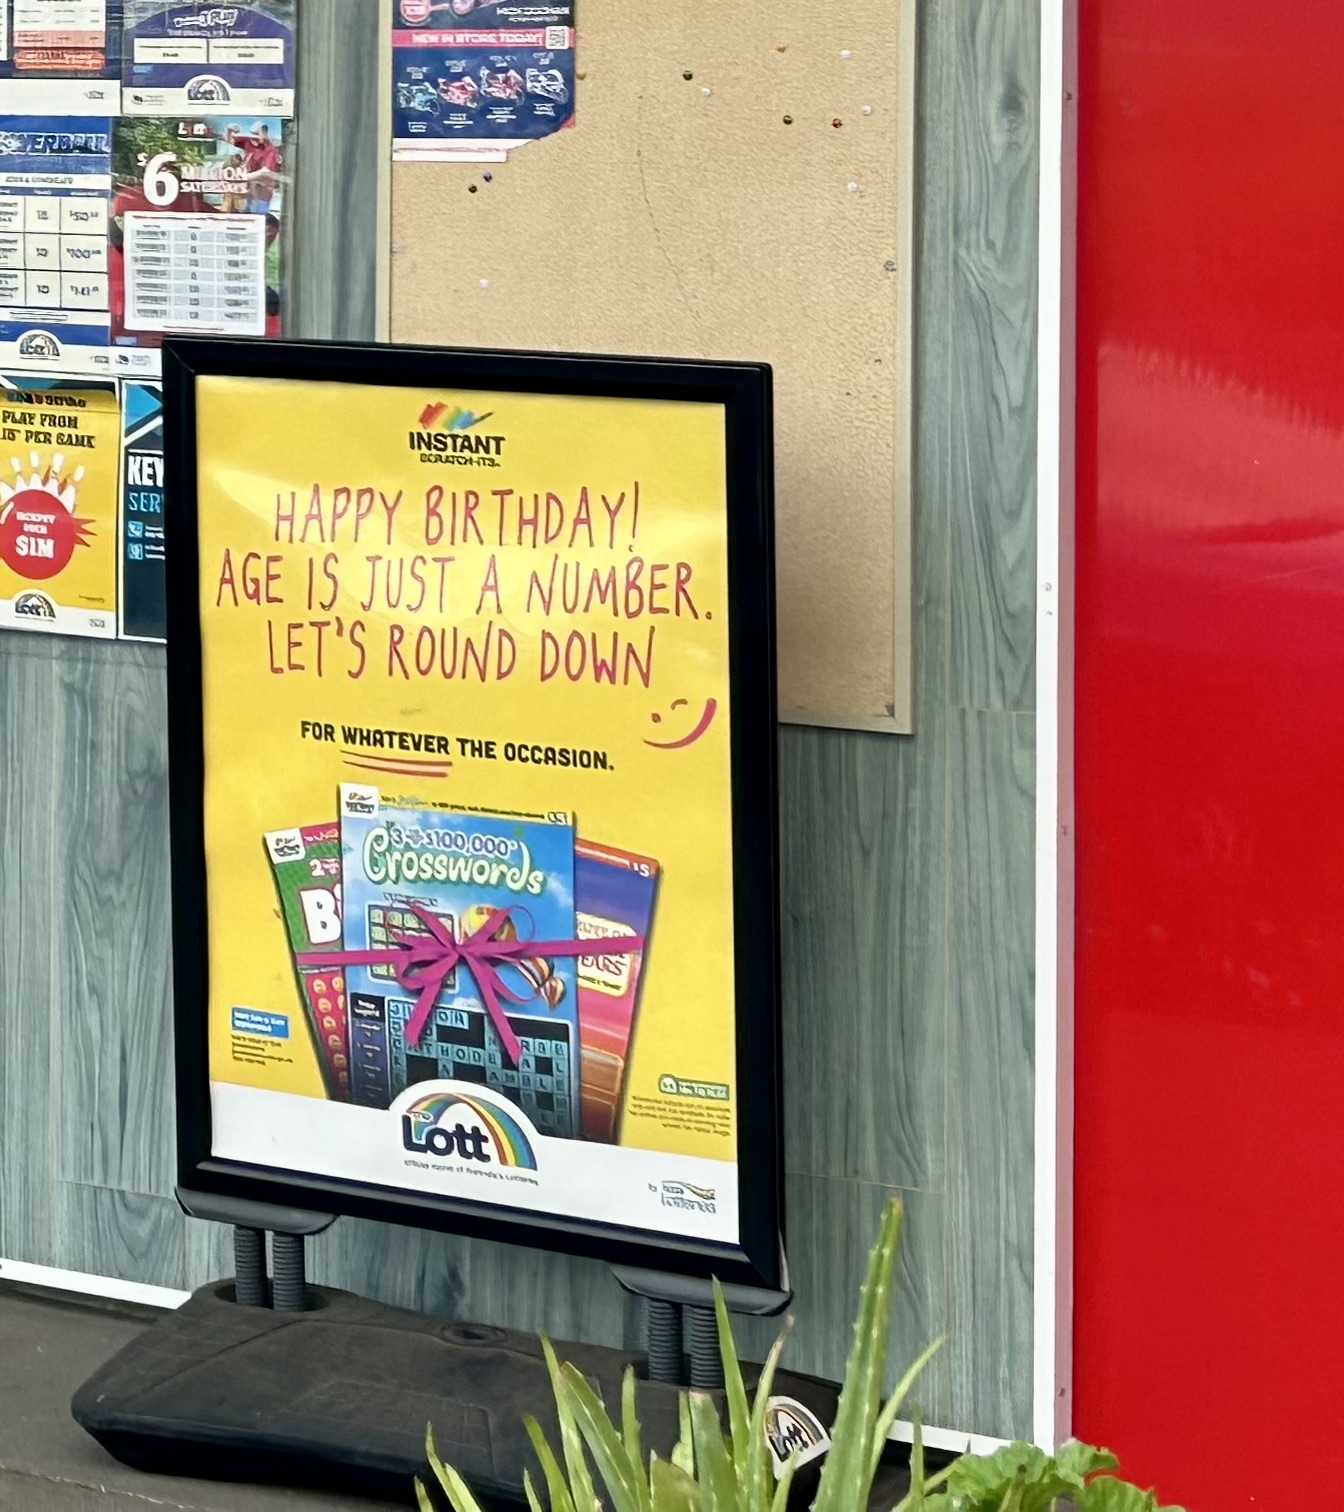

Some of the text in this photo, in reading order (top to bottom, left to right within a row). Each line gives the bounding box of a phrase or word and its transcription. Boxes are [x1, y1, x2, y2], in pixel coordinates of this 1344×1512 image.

[1, 409, 36, 426] PLAY
[24, 429, 53, 445] PER
[409, 431, 506, 455] INSTANT
[128, 492, 163, 513] SER
[274, 480, 640, 553] HAPPY BIRTHDAY!
[216, 548, 714, 620] AGE IS JUST A NUMBER.
[267, 615, 656, 689] LET'S ROUND DOWN
[300, 720, 616, 772] FOR WHATEVER THE OCCASION.
[363, 825, 545, 896] Crosswords
[299, 888, 341, 944] B
[401, 1112, 491, 1165] Lott
